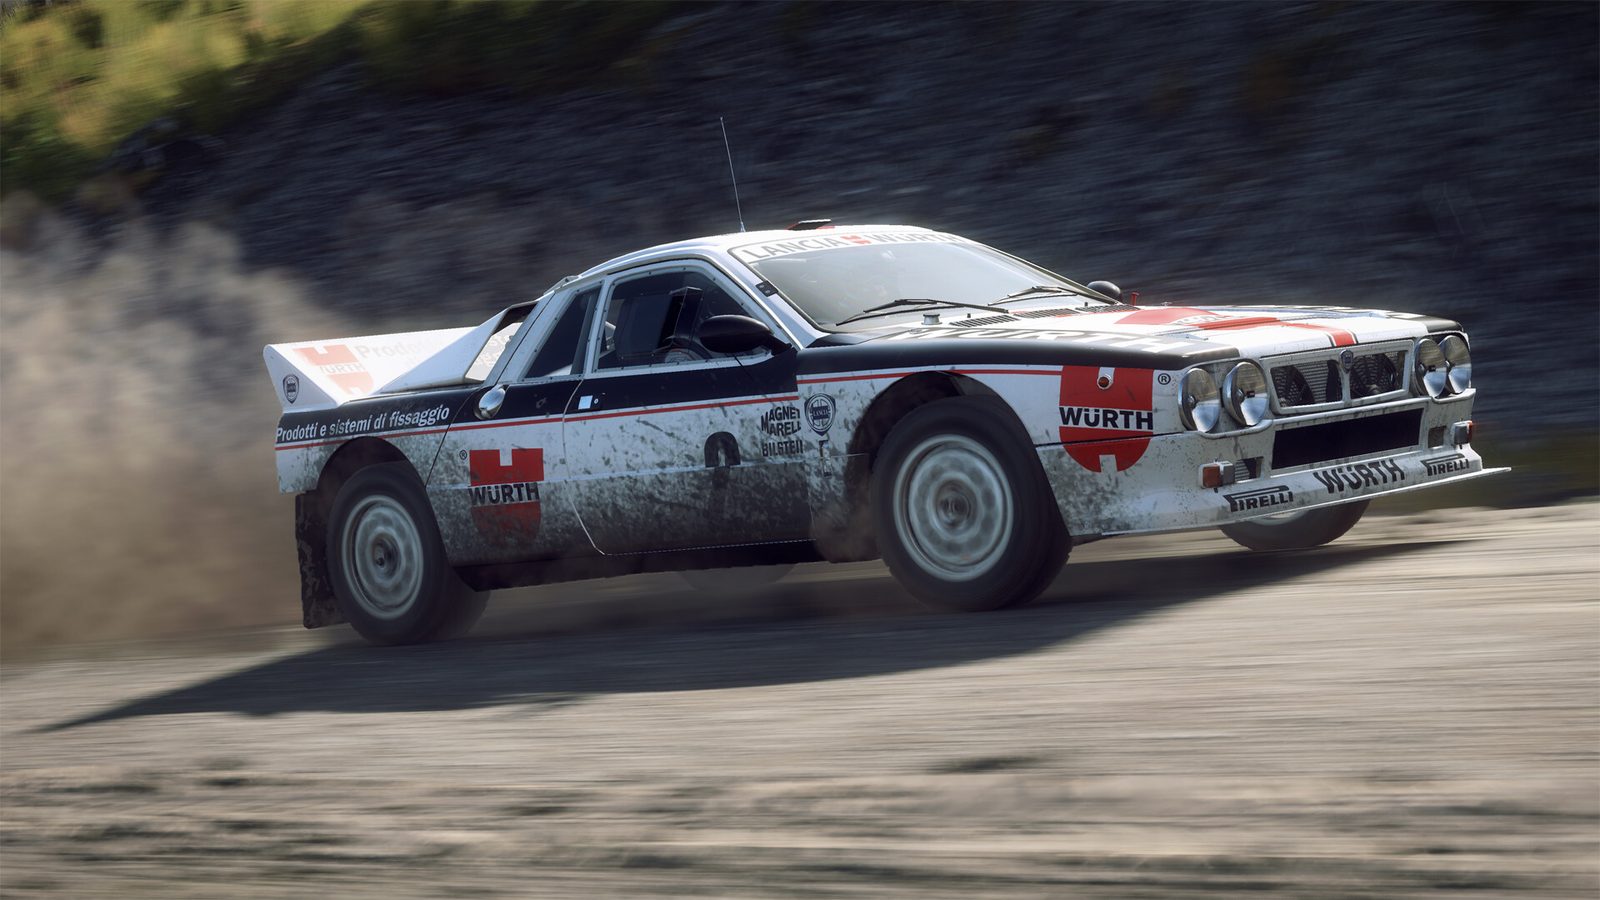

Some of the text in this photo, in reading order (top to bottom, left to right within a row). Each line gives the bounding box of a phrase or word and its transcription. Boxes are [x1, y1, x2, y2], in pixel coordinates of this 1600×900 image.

[742, 238, 850, 258] LANCIA
[275, 404, 450, 442] Prodotti e sistemi di fissaggio
[1059, 407, 1153, 430] WÜRTH
[1313, 458, 1405, 494] WÜRTH
[1420, 453, 1470, 476] PIRELLI
[468, 482, 540, 505] WÜRTH
[1222, 485, 1294, 512] PIRELLI
